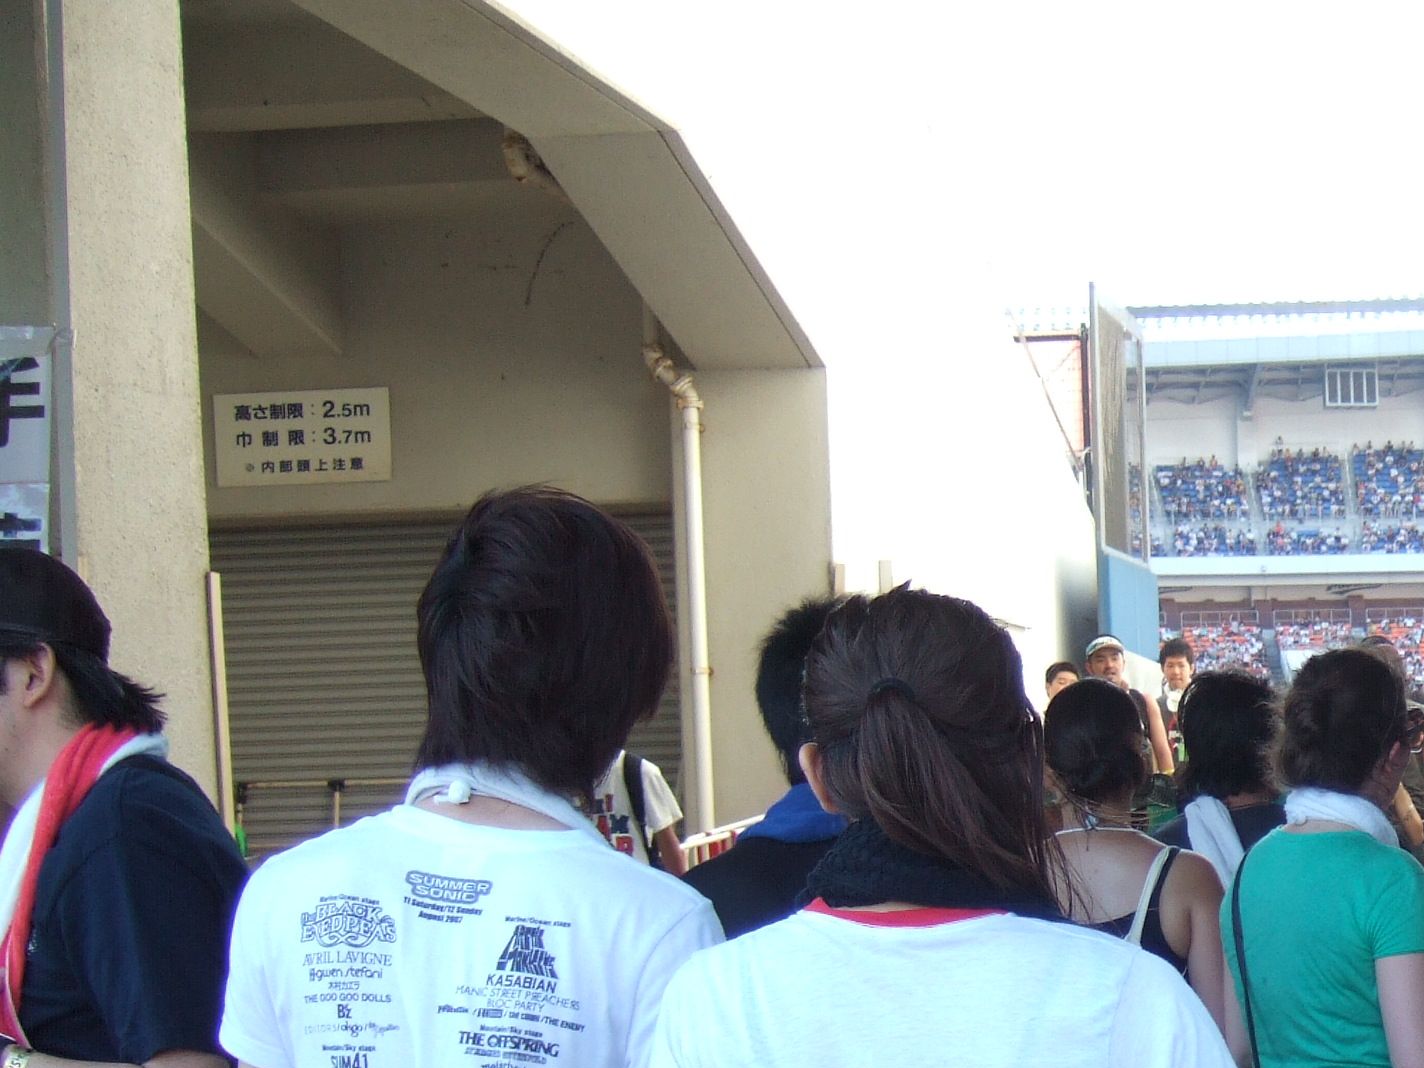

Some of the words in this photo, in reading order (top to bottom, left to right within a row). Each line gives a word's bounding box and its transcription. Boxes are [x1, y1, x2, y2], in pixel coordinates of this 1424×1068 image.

[408, 873, 491, 895] SUMMER
[414, 885, 477, 900] SONIC
[316, 901, 384, 923] BLACK
[418, 910, 444, 922] August
[303, 952, 336, 966] AVRIL
[337, 952, 392, 967] LAVIGNE
[486, 973, 558, 994] KASABIAN
[361, 993, 392, 1003] DOLLS
[514, 1000, 546, 1013] PARTY
[458, 1031, 485, 1047] THE
[487, 1034, 560, 1058] OFFSPRING
